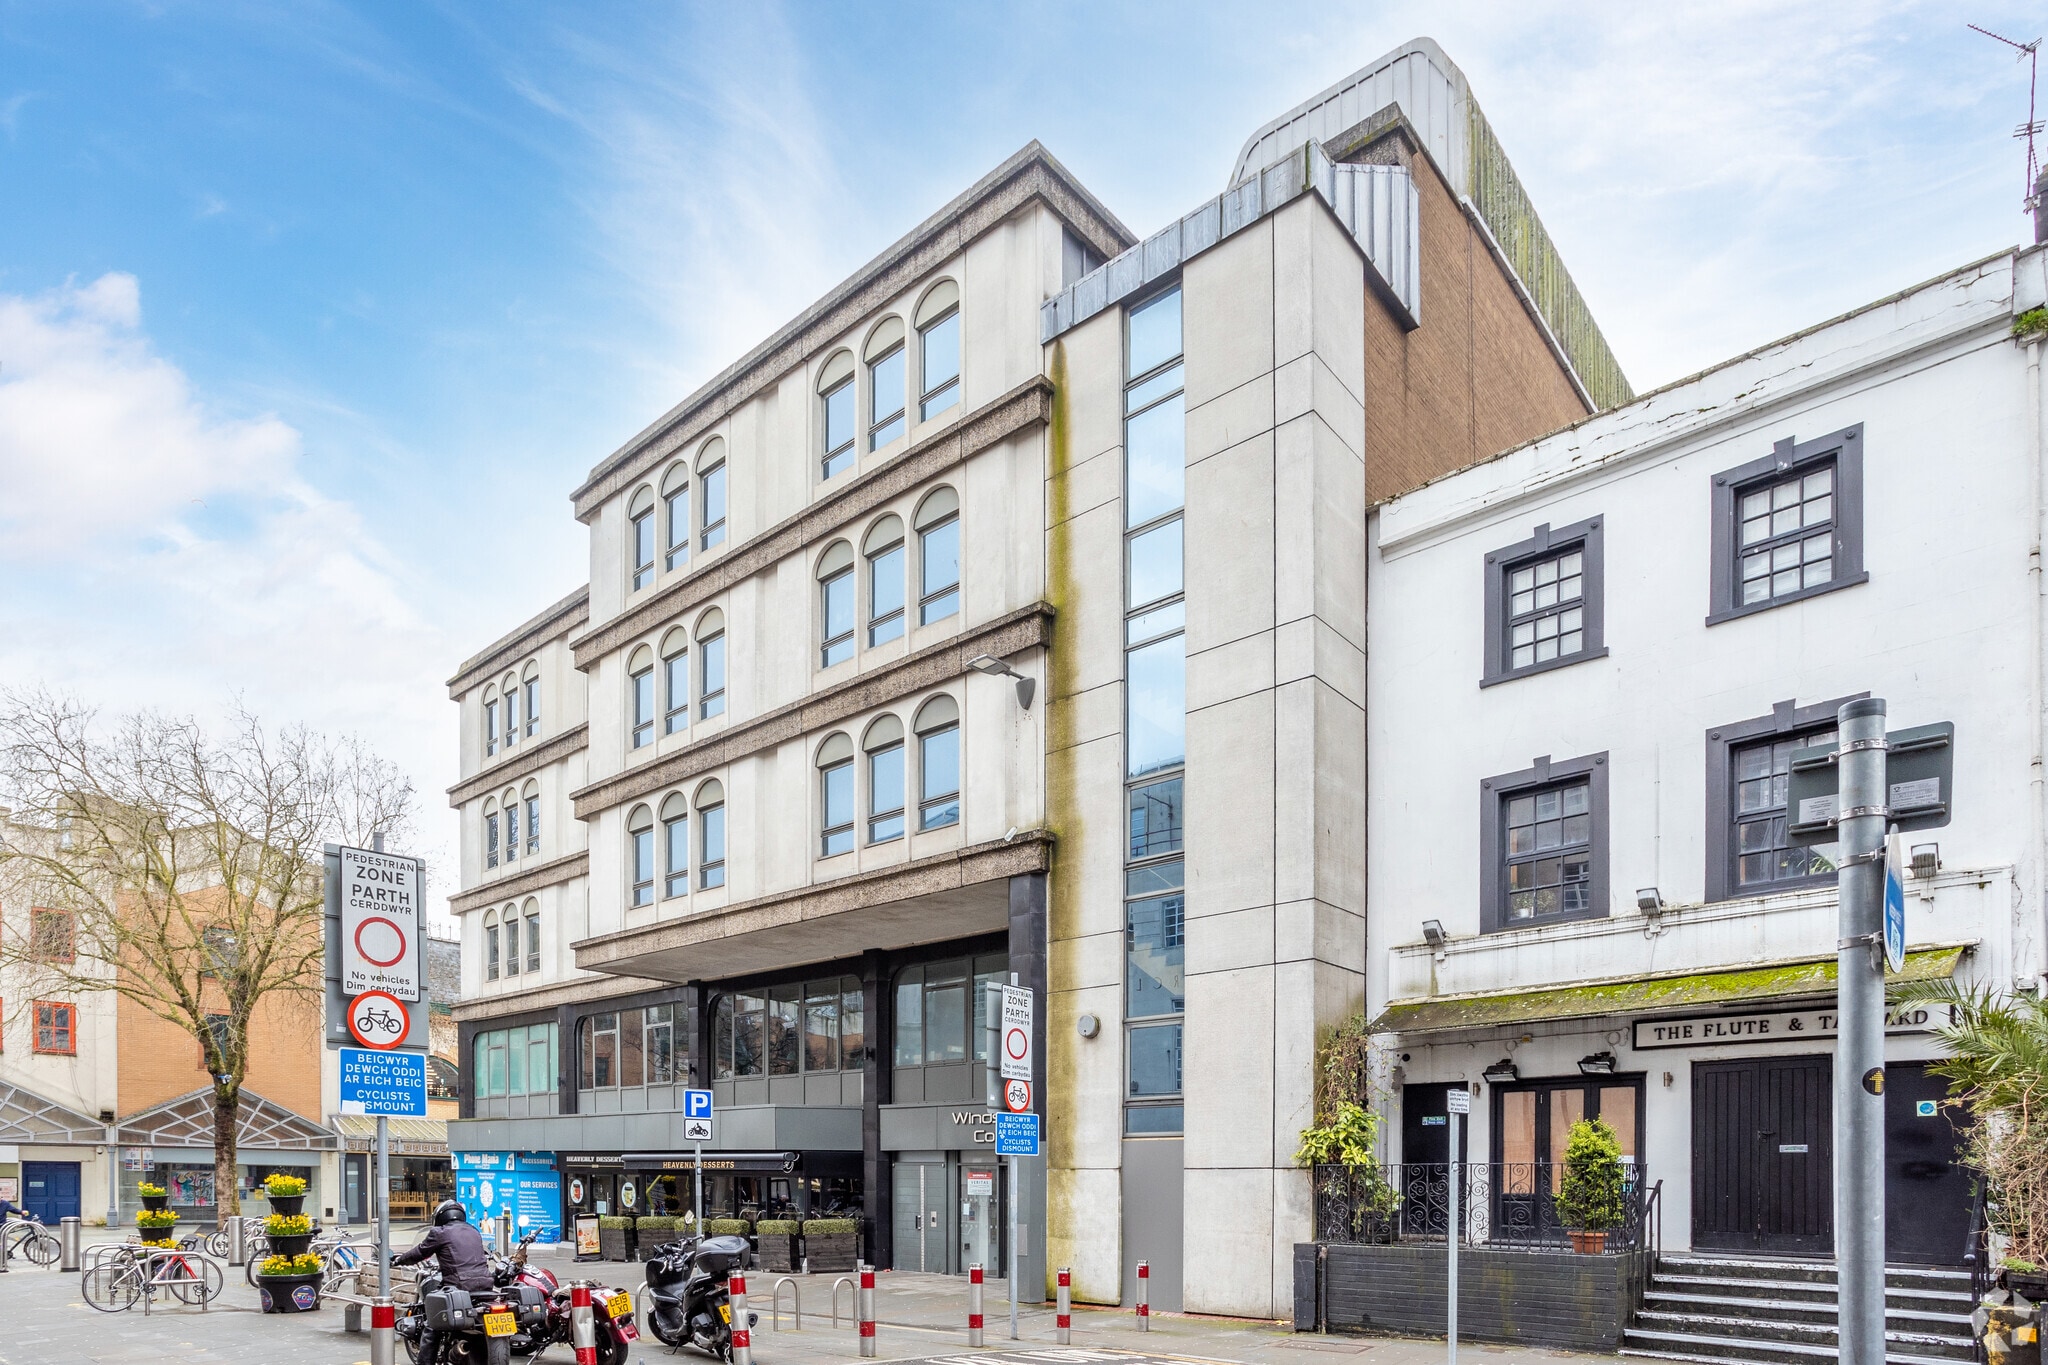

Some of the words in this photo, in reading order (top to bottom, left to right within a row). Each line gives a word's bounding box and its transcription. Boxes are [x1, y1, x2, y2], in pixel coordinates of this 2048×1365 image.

[346, 852, 414, 872] PEDESTRIAN
[356, 866, 404, 886] ZONE
[352, 884, 410, 904] PARTH
[350, 898, 412, 916] CERDDWYR
[352, 970, 366, 980] No
[370, 974, 410, 985] vehicles
[346, 980, 366, 990] Dim
[370, 985, 416, 996] cerbydau
[1004, 988, 1032, 998] PEDESTRIAN
[1008, 996, 1028, 1008] ZONE
[1006, 1008, 1030, 1020] PARTH
[1004, 1016, 1030, 1026] CERDDWYR
[1654, 1026, 1693, 1040] THE
[1704, 1020, 1770, 1037] FLUTE
[1788, 1018, 1804, 1032] &
[358, 1054, 409, 1066] BEICWYR
[346, 1064, 388, 1075] DEWCH
[392, 1067, 420, 1077] ODDI
[344, 1074, 360, 1084] AR
[364, 1075, 391, 1085] EICH
[396, 1078, 422, 1088] BEIC
[356, 1090, 410, 1101] CYCLISTS
[354, 1100, 416, 1112] SMOUNT
[691, 1093, 708, 1116] P
[464, 1154, 480, 1164] Phone
[482, 1154, 499, 1164] Mania
[610, 1294, 628, 1307] CE19
[486, 1314, 513, 1324] OV68
[492, 1324, 511, 1333] HVG
